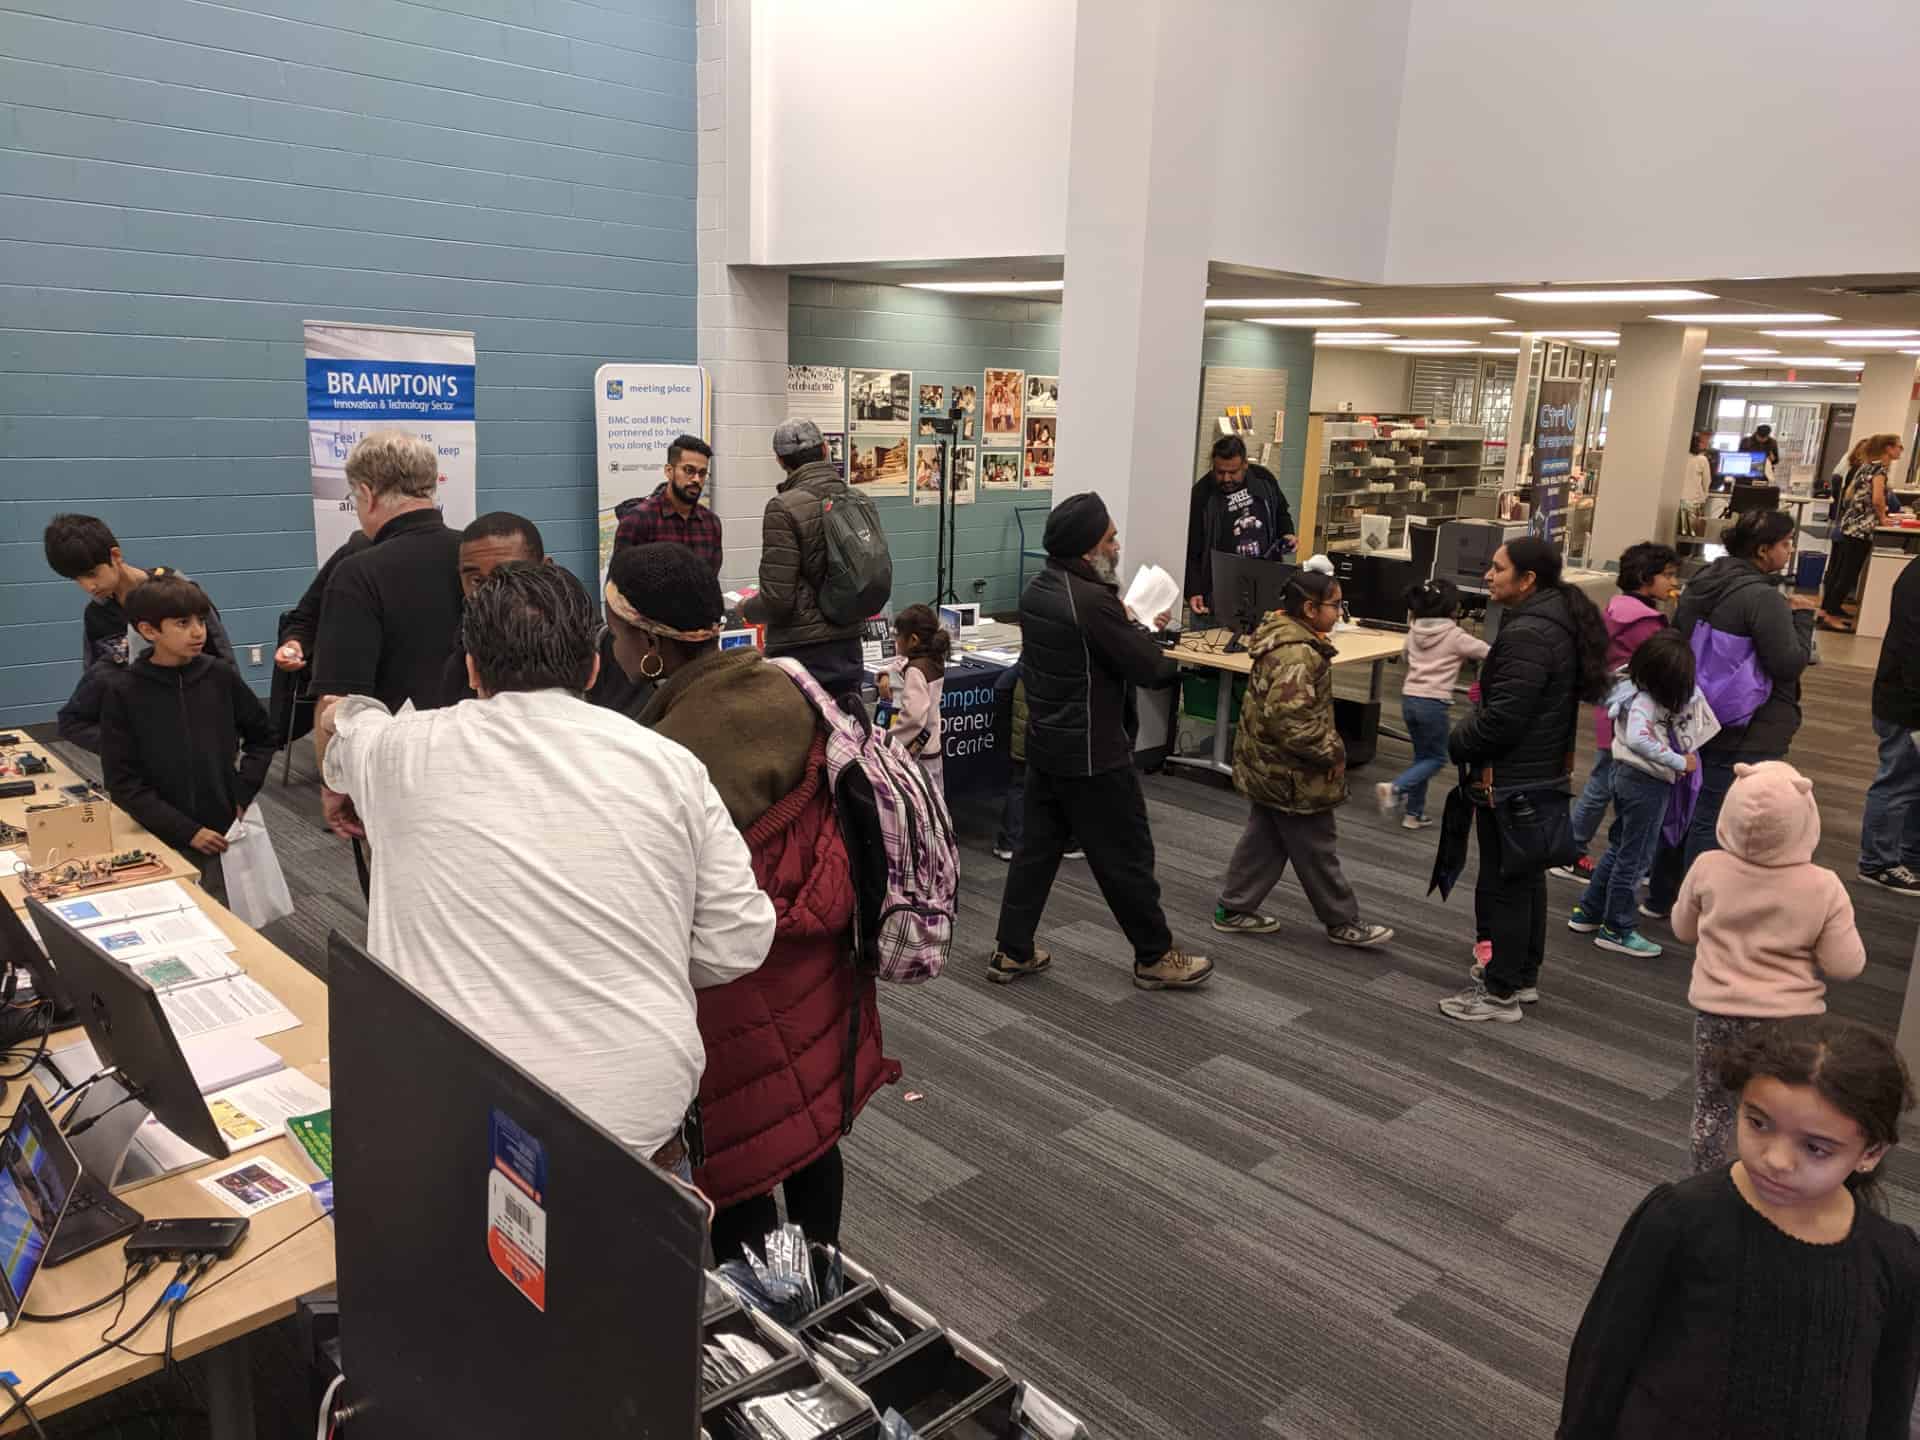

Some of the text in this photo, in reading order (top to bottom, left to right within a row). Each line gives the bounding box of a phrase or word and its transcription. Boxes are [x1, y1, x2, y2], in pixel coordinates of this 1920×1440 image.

[327, 372, 458, 396] BRAMPTON'S
[630, 384, 665, 395] meeting
[667, 384, 691, 394] place
[333, 399, 454, 412] Innovation & Technology Sector
[608, 416, 629, 424] BMC
[631, 416, 648, 424] and
[670, 416, 690, 424] have
[333, 432, 356, 443] Feel
[608, 428, 653, 438] partnered
[608, 443, 625, 451] you
[627, 440, 652, 451] along
[335, 445, 460, 459] by keep
